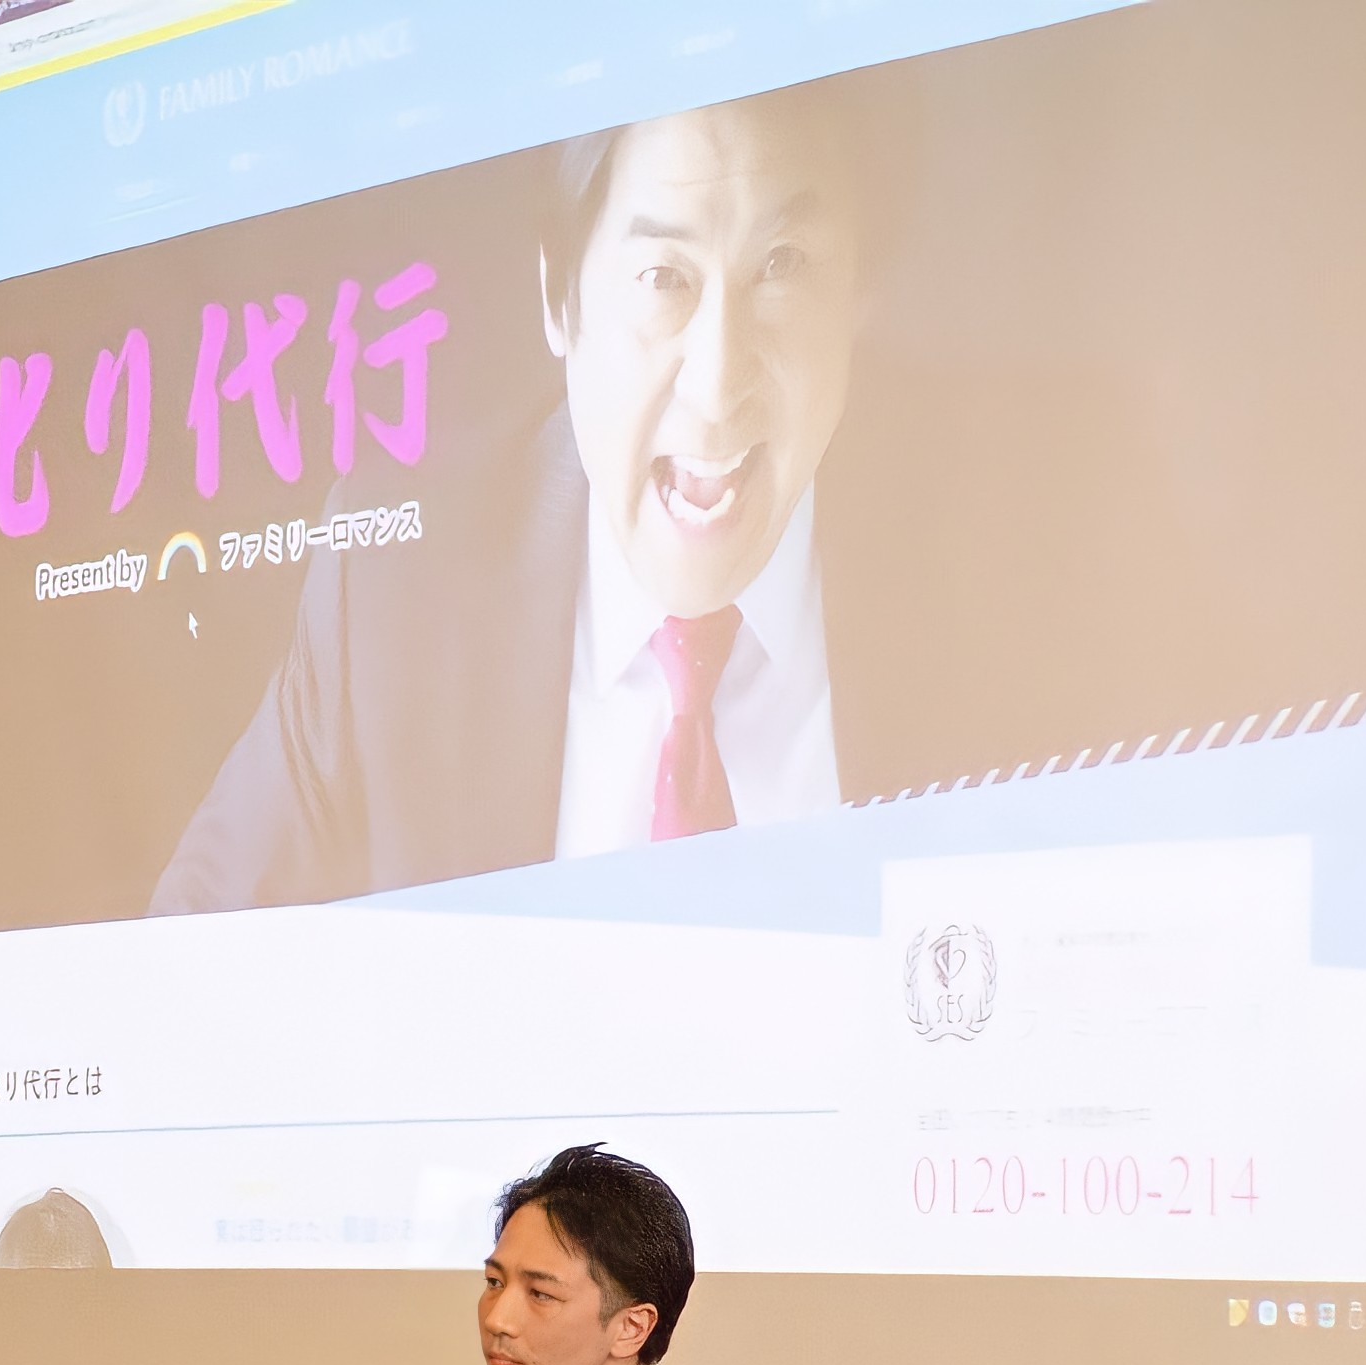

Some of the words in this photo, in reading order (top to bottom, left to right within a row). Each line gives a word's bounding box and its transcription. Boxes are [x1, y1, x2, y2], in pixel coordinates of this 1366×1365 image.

[159, 63, 257, 120] FAMILY
[264, 18, 413, 91] ROMANCE
[219, 501, 422, 571] ファミリーロマンス
[37, 557, 115, 599] Present
[117, 549, 147, 592] by
[913, 1155, 1260, 1216] 0120-100-214
